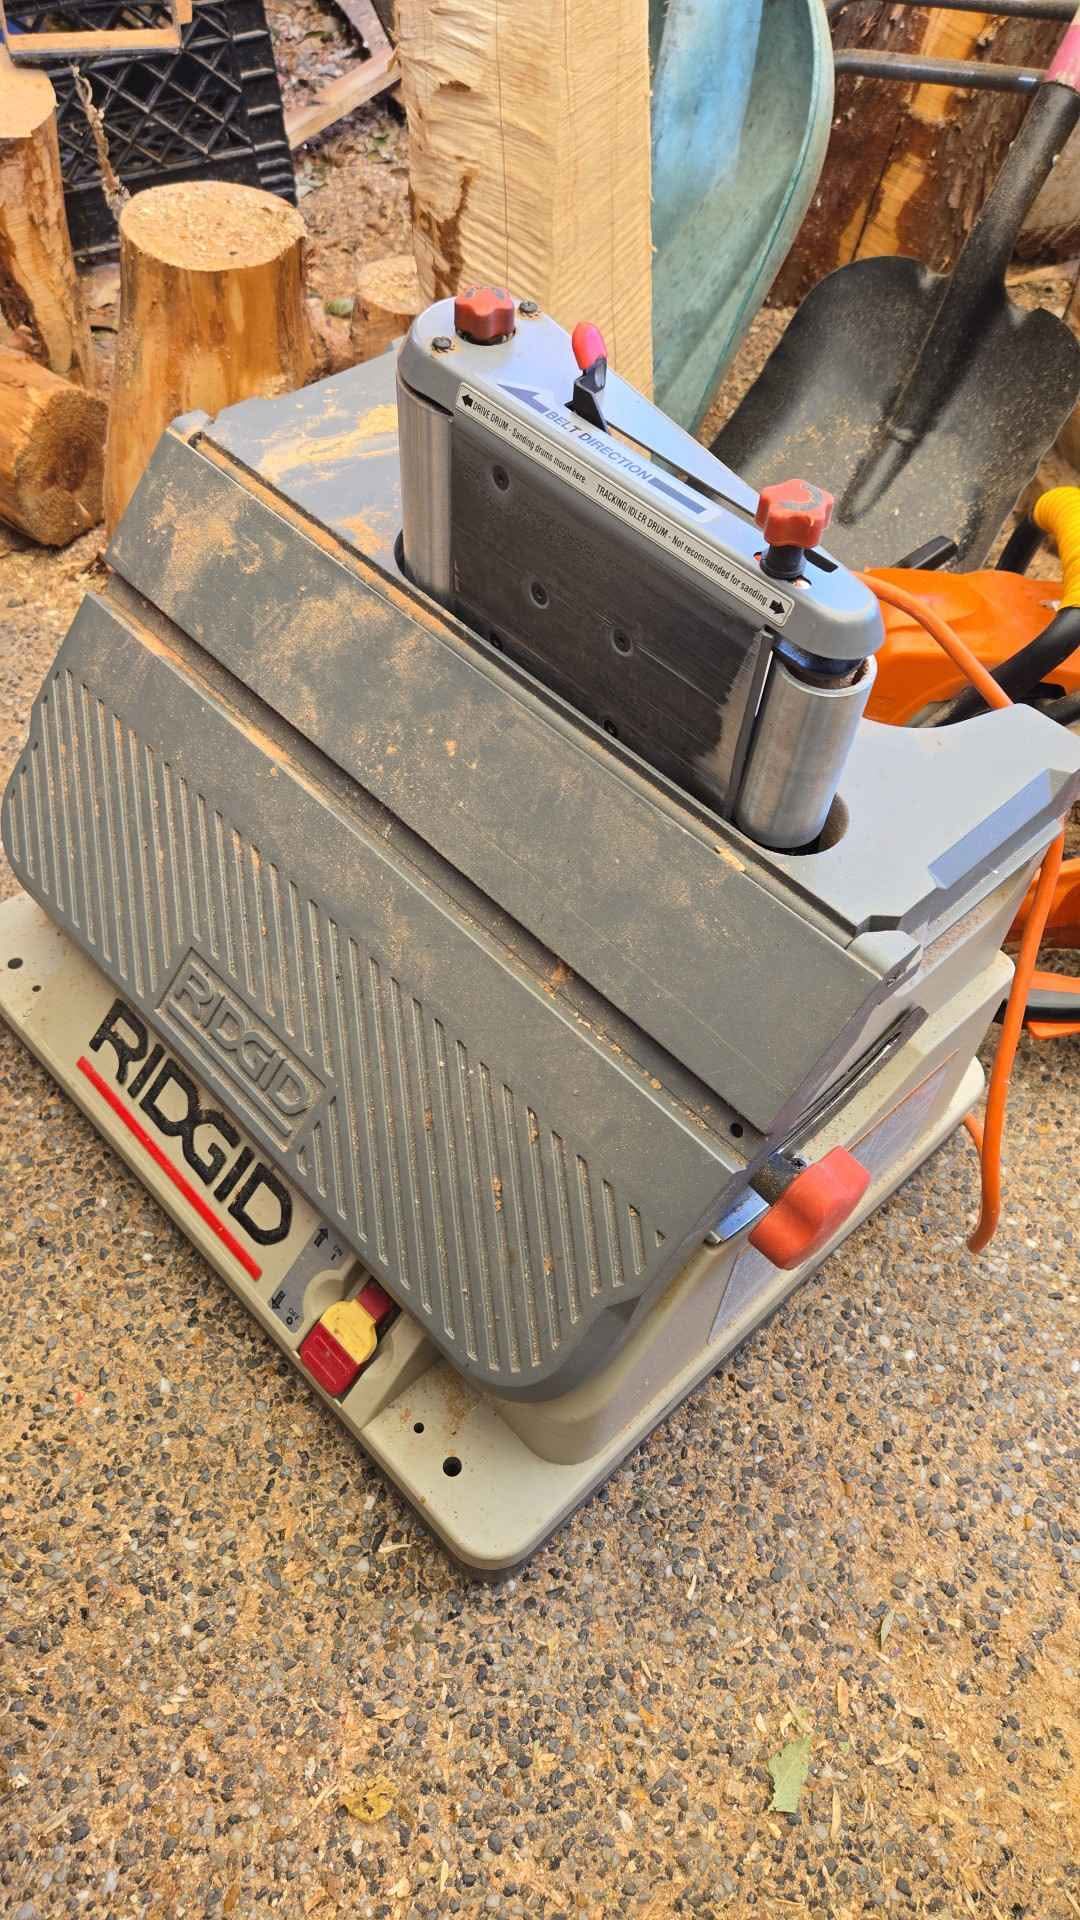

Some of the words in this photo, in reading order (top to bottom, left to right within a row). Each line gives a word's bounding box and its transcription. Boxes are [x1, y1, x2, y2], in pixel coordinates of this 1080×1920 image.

[472, 401, 491, 420] DRIVE
[490, 412, 509, 431] DRUM
[512, 427, 534, 451] Sanding
[534, 444, 554, 462] drums
[553, 457, 573, 475] mount
[545, 411, 582, 433] BELT
[578, 432, 652, 480] DIRECTION
[596, 484, 648, 524] TRACKING/IDLER
[647, 518, 669, 539] DRUM
[672, 535, 685, 548] Not
[684, 545, 730, 580] recommended
[730, 574, 741, 587] for
[172, 966, 314, 1117] RIDGID
[88, 997, 293, 1246] RIDGID
